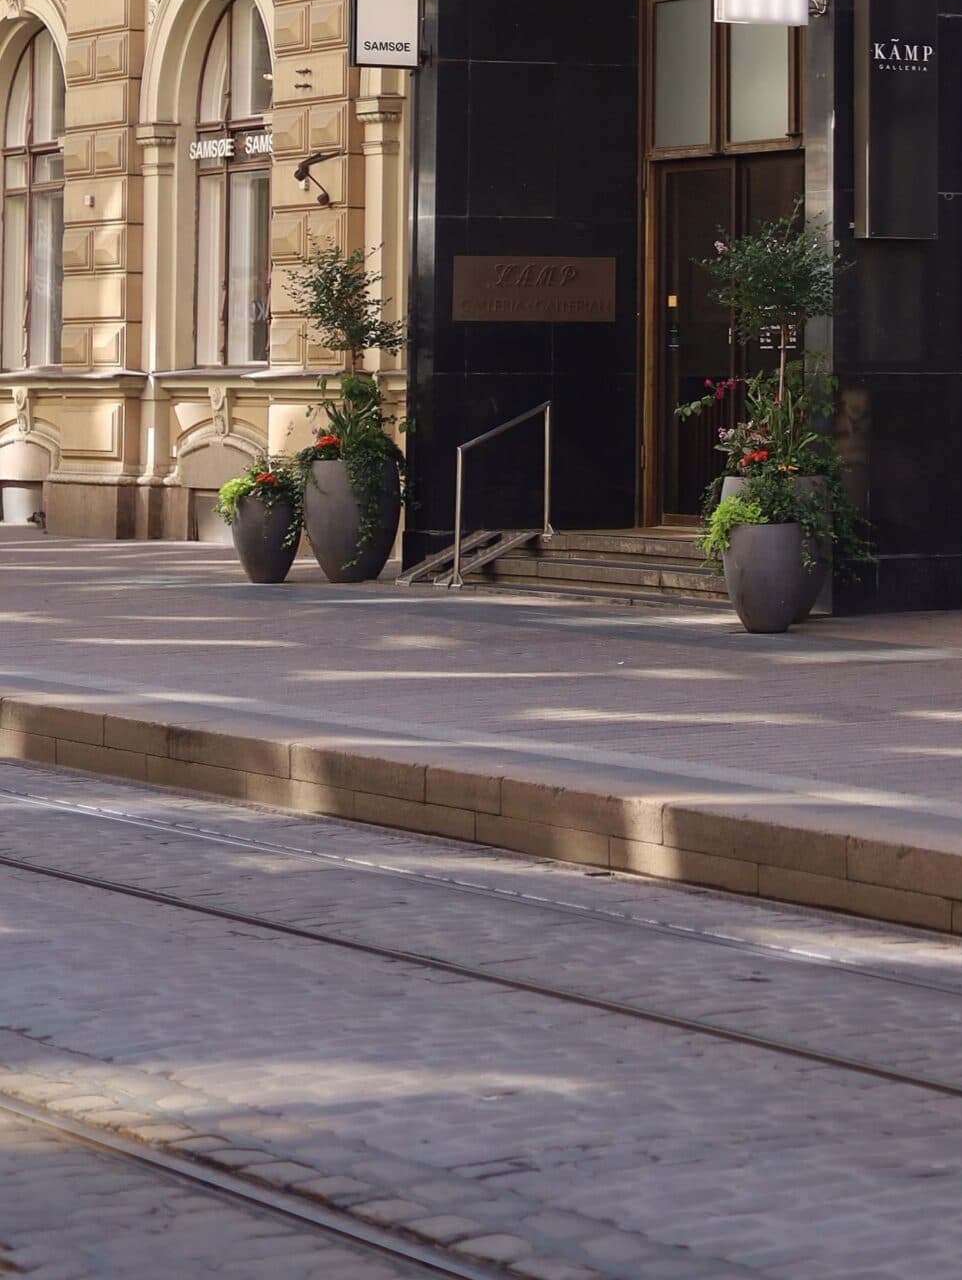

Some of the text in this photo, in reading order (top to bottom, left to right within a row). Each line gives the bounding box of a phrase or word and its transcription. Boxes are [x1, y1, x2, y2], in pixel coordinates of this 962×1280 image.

[363, 40, 411, 52] SAMSØE
[878, 64, 928, 72] GALLERIA
[189, 138, 235, 160] SAMSØE
